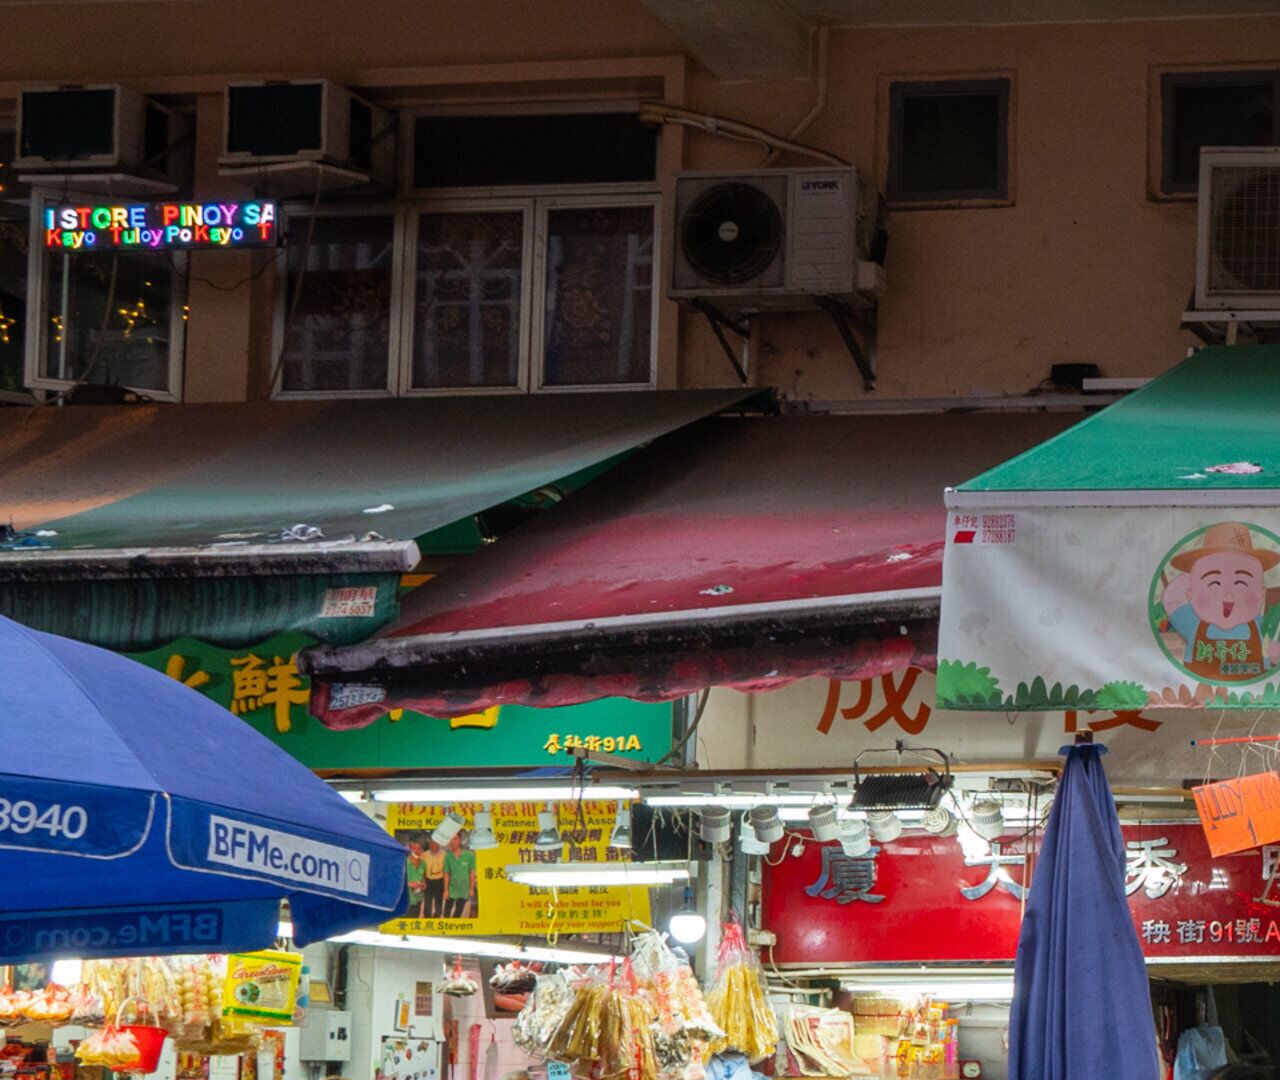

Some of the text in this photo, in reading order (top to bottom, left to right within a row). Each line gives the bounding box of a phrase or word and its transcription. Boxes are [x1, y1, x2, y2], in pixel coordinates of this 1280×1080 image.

[810, 181, 839, 190] YORK
[60, 206, 147, 229] STORE
[163, 204, 238, 227] PINOY
[46, 228, 97, 249] Kayo
[110, 226, 163, 247] Tuloy
[165, 226, 192, 244] Po
[194, 225, 244, 246] Kayo
[397, 818, 423, 831] Hong
[495, 817, 536, 829] Fattener
[213, 823, 341, 884] BFMe.com
[437, 920, 473, 931] Steven
